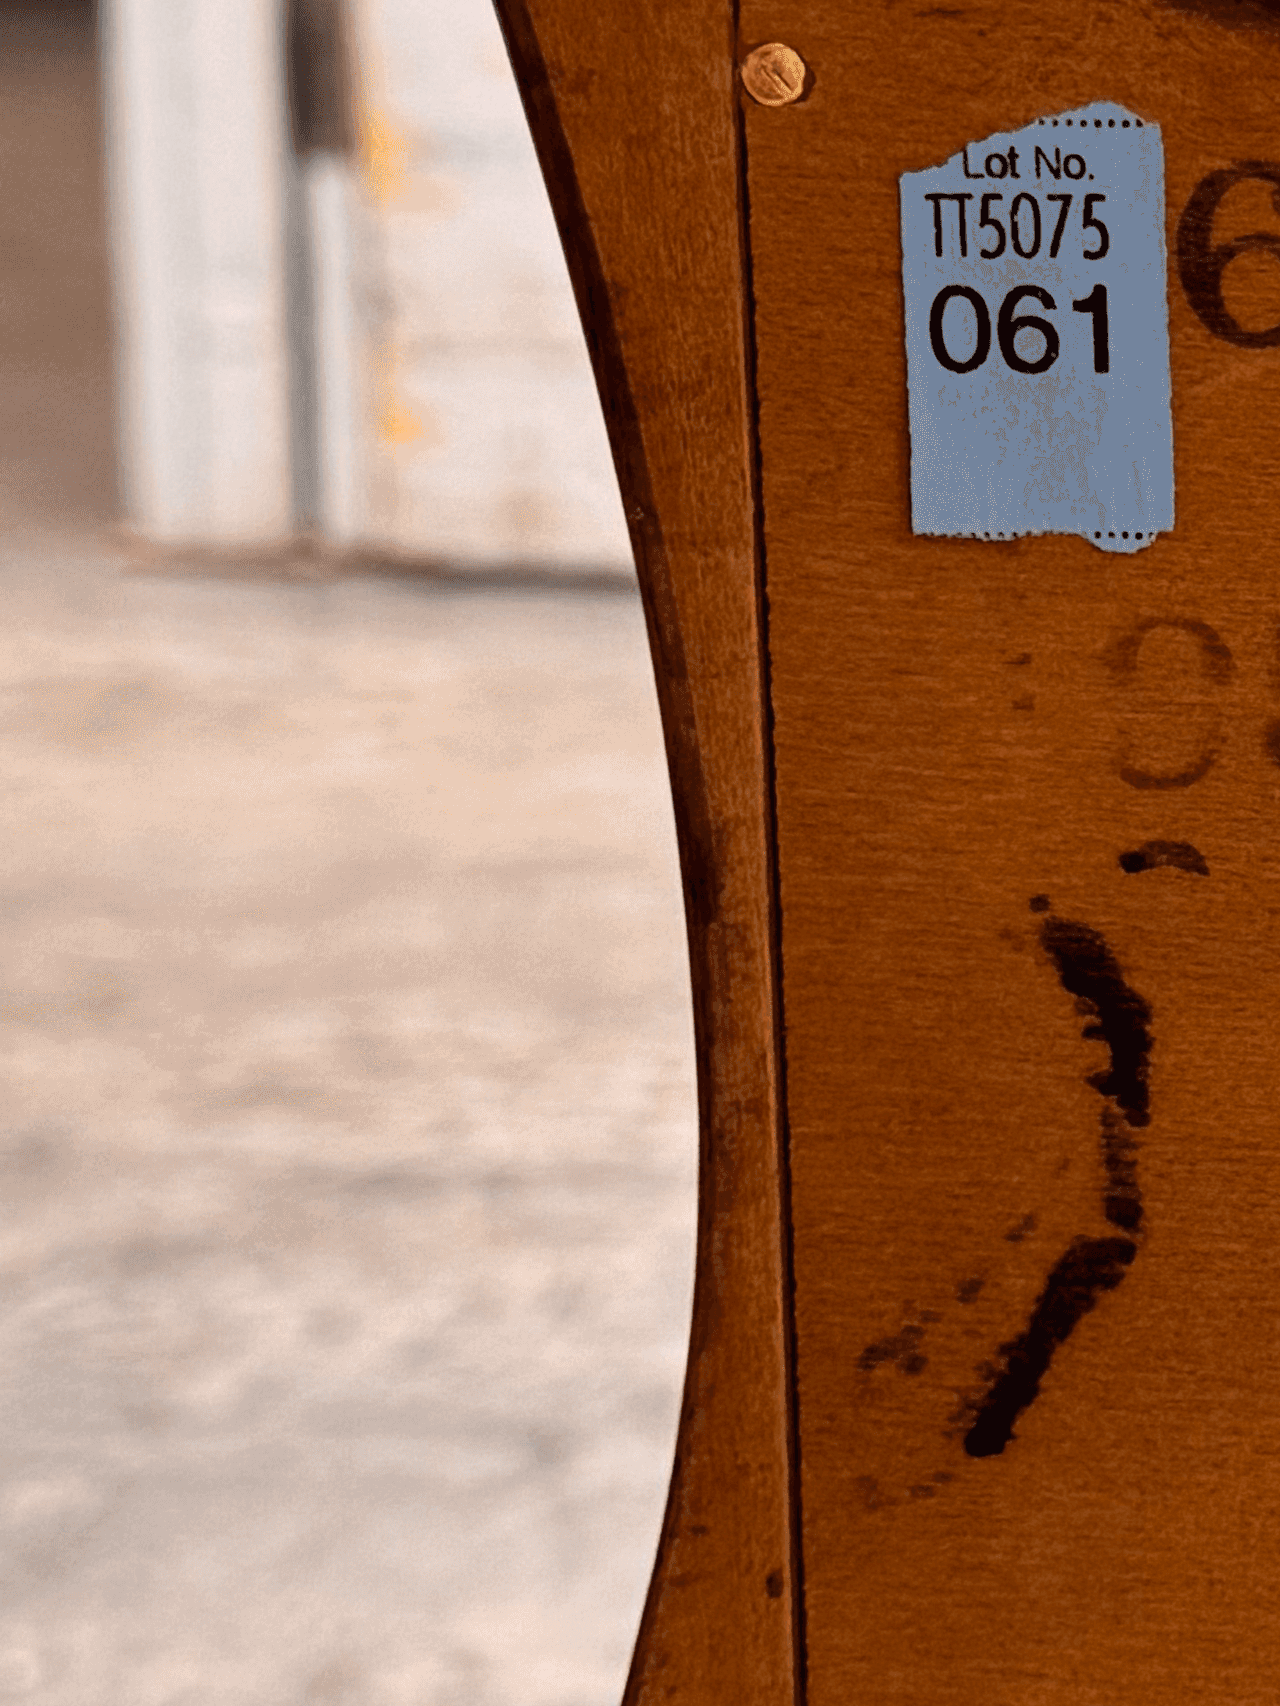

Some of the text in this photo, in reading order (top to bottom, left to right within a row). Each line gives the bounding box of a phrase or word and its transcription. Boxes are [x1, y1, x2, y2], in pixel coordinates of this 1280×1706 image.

[962, 145, 1095, 181] Lot No.
[923, 192, 1110, 261] TT5075
[928, 283, 1110, 375] 061
